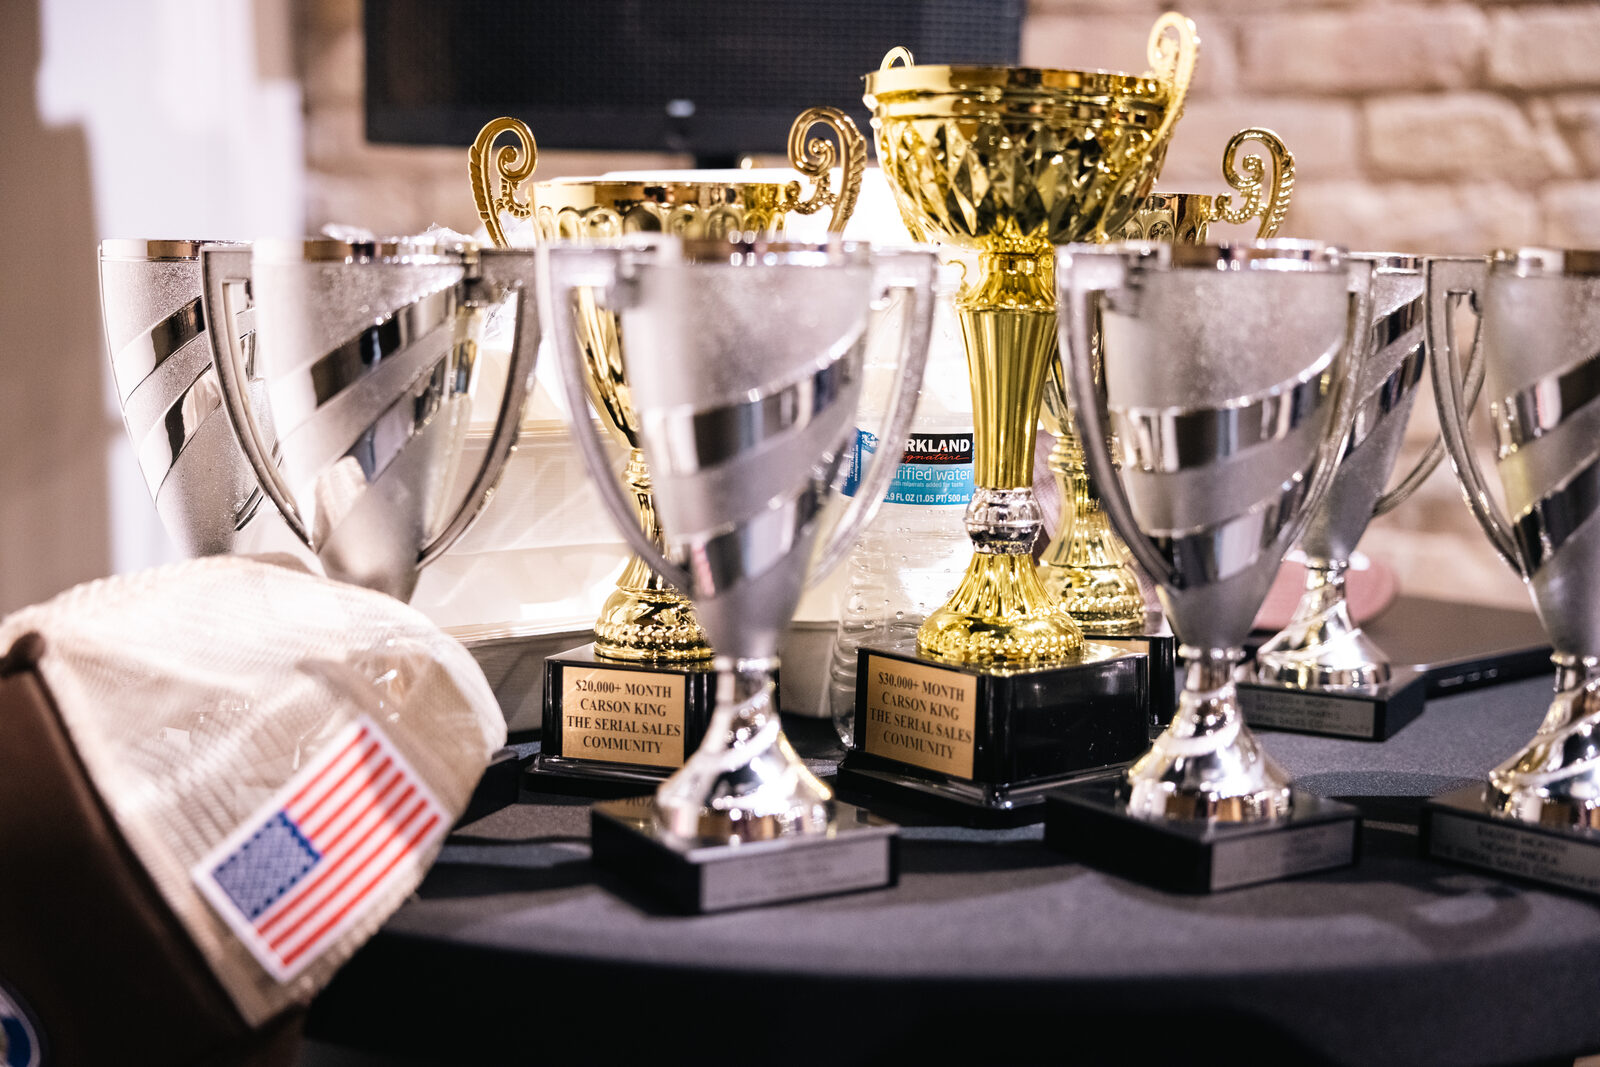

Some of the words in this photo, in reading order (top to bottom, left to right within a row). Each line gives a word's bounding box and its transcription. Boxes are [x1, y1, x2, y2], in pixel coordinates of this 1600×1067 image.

[904, 439, 970, 453] RKLAND
[903, 452, 969, 464] ignature
[896, 467, 932, 481] rified
[936, 468, 971, 481] water
[896, 493, 905, 502] FL
[905, 493, 915, 502] OZ
[916, 494, 935, 503] (1.05
[948, 494, 960, 502] 500
[624, 683, 672, 698] MONTH
[922, 680, 965, 702] MONTH
[580, 698, 631, 714] CARSON
[634, 702, 667, 717] KING
[882, 691, 927, 712] CARSON
[929, 702, 959, 721] KING
[567, 715, 592, 729] THE
[594, 718, 640, 733] SERIAL
[641, 722, 681, 737] SALES
[870, 707, 892, 724] THE
[894, 713, 934, 735] SERIAL
[936, 723, 972, 744] SALES
[583, 735, 663, 754] COMMUNITY
[883, 730, 955, 759] COMMUNITY
